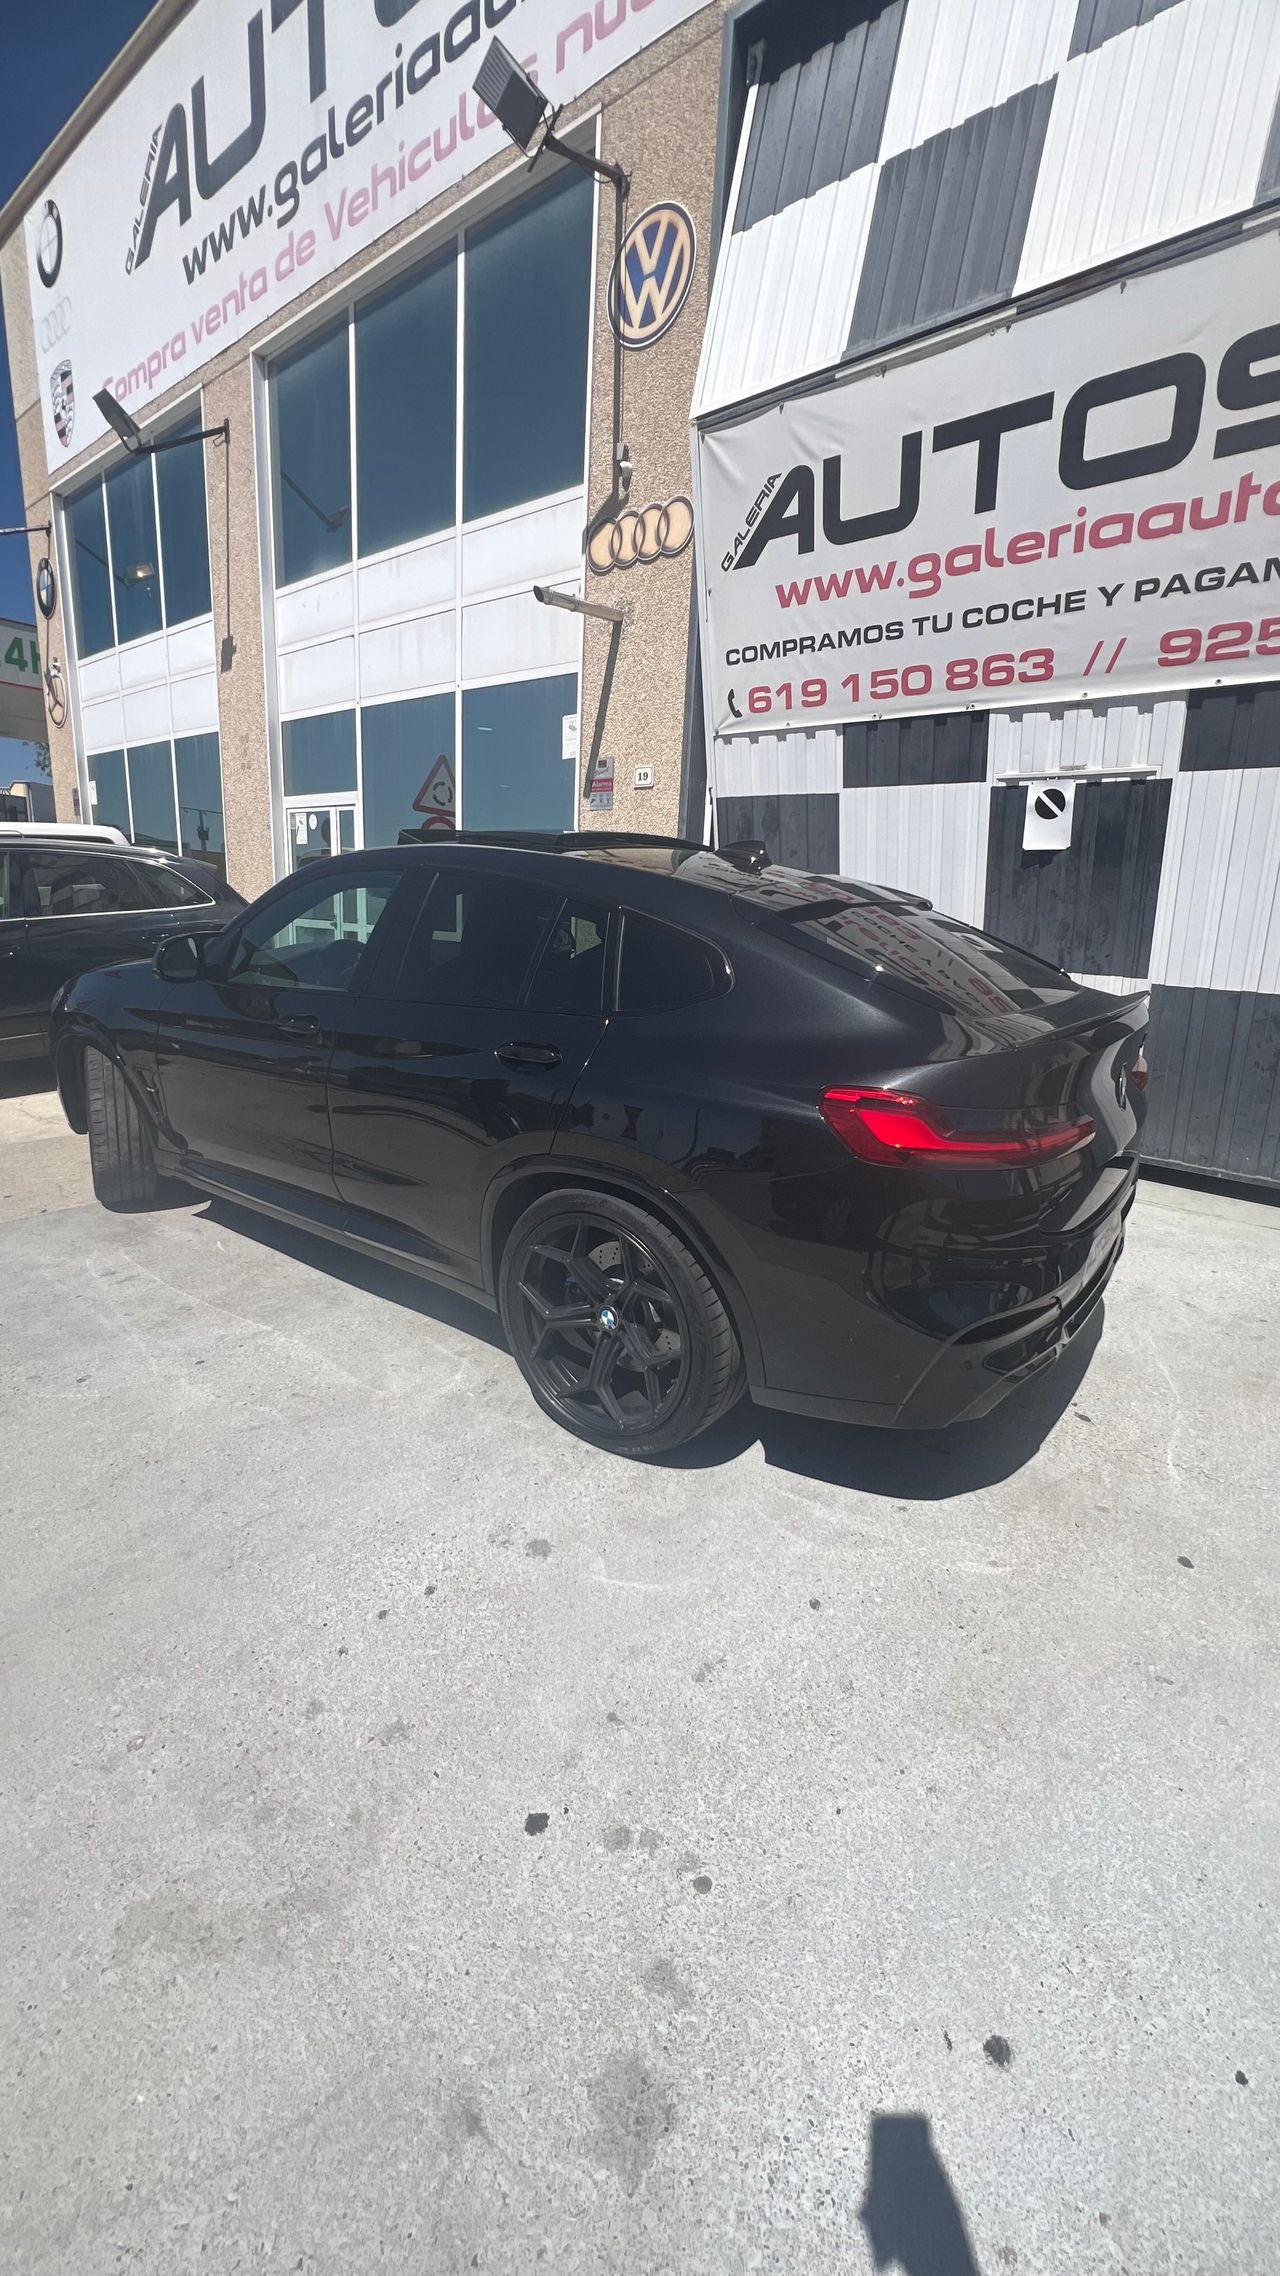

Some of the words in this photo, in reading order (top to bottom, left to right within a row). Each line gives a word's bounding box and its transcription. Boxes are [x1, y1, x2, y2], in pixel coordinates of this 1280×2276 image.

[134, 0, 420, 270] AUT
[181, 0, 525, 286] www.galeriaau
[191, 265, 268, 345] venta
[275, 230, 316, 282] de
[720, 472, 783, 572] GALERIA
[725, 621, 904, 666] COMPRAMOS
[912, 612, 953, 636] TU
[962, 589, 1087, 629] COCHE
[1097, 583, 1125, 607] Y
[748, 678, 828, 714] 619
[841, 664, 932, 702] 150
[945, 648, 1055, 692] 863
[637, 771, 649, 781] 19
